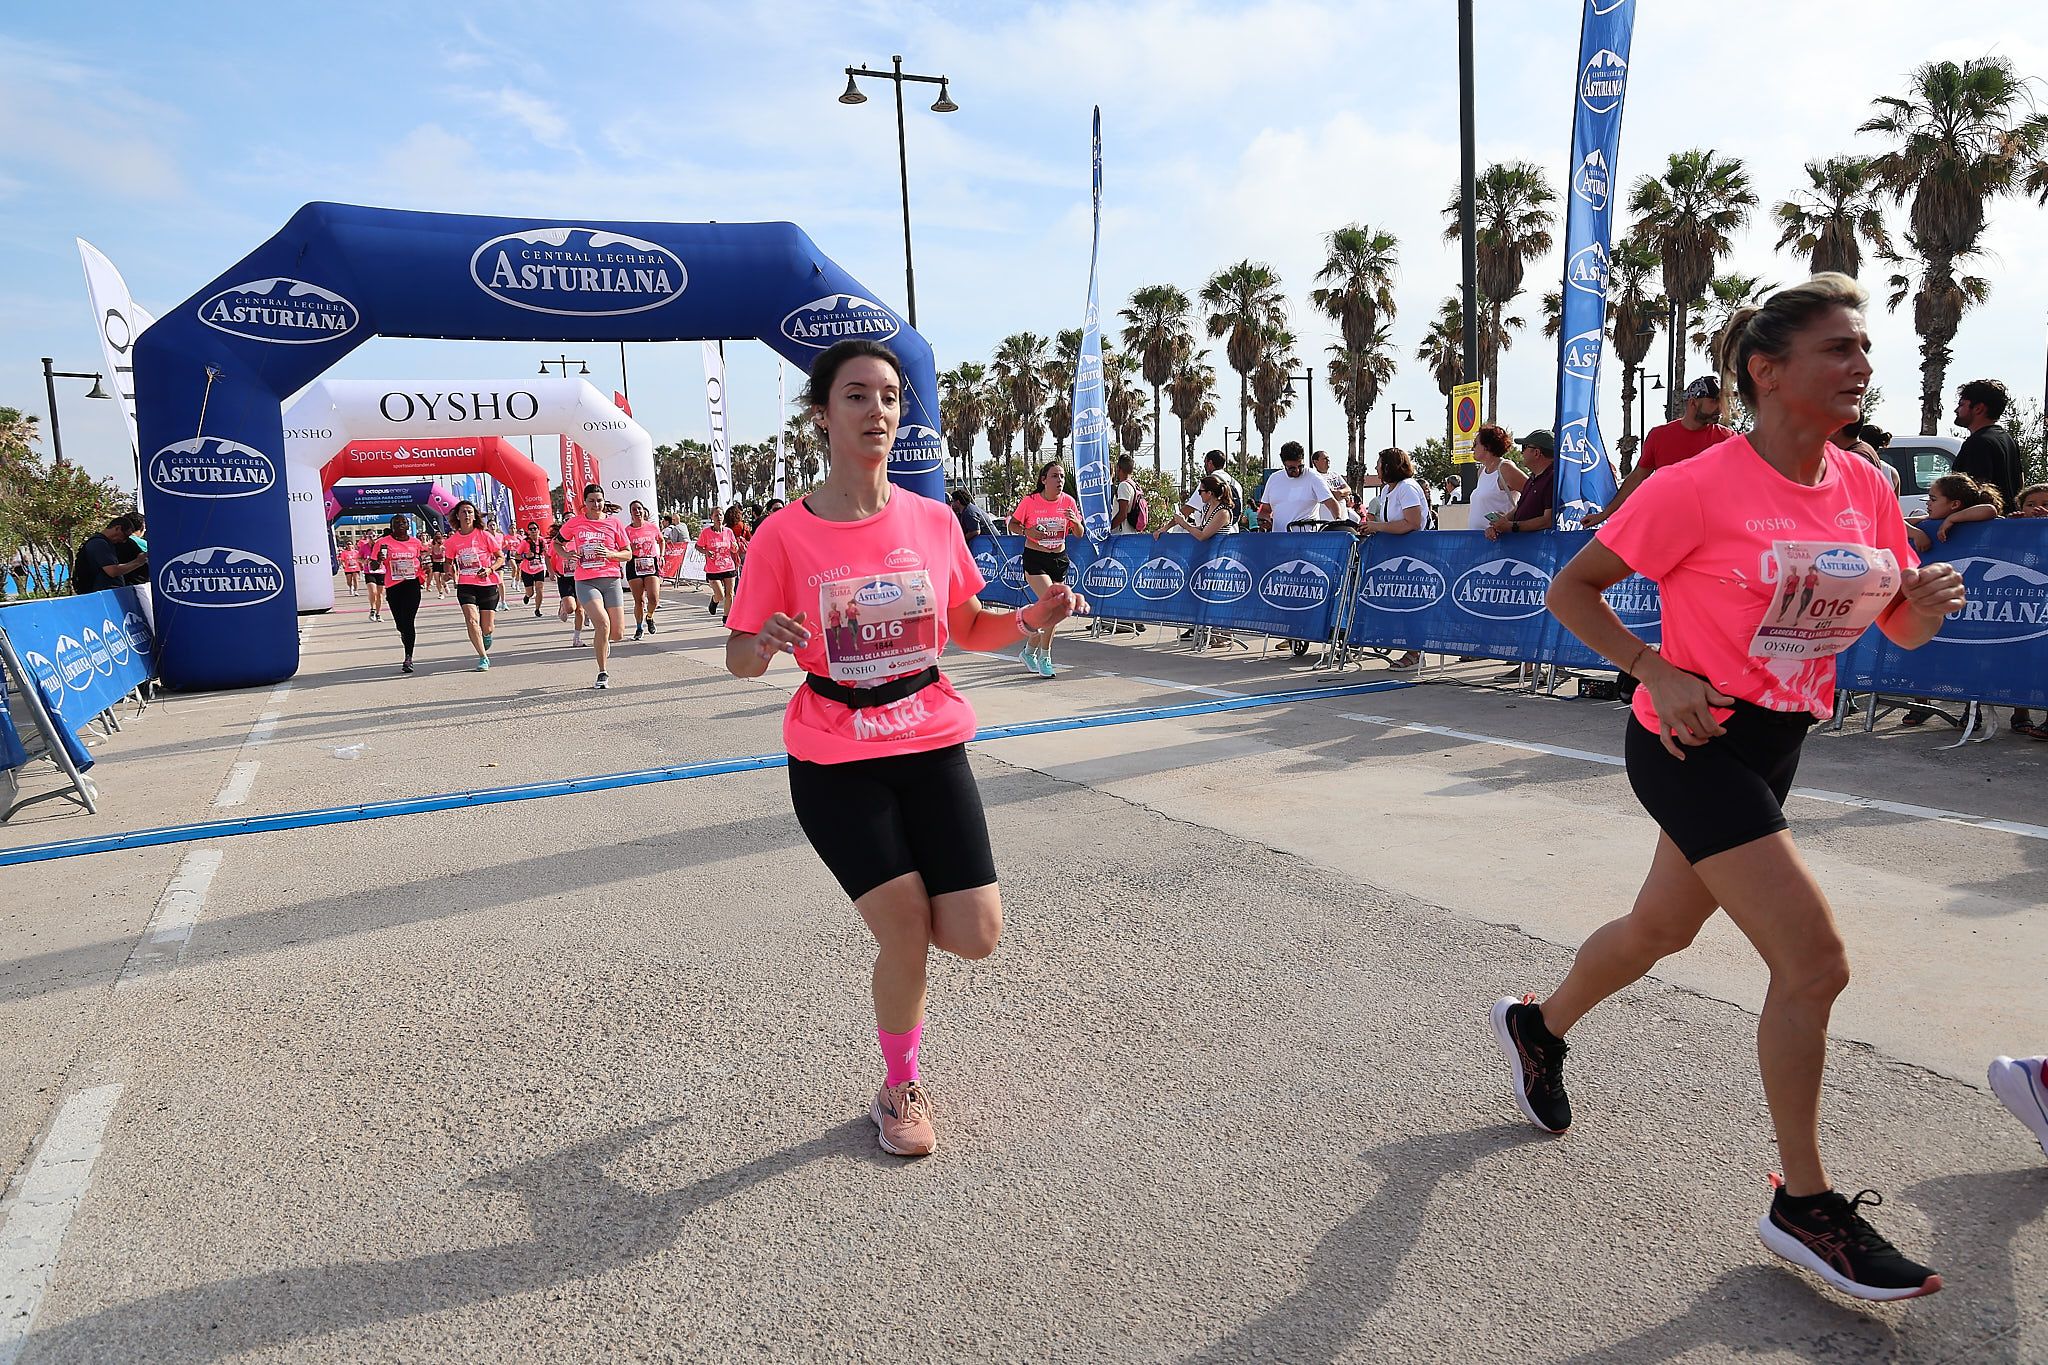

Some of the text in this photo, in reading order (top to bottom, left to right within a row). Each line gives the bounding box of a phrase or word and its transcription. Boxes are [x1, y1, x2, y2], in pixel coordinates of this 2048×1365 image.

[521, 250, 665, 264] CENTRAL LECHERA
[489, 250, 674, 294] ASTURIANA
[235, 297, 345, 312] CENTRAL LECHERA
[208, 299, 348, 330] ASTURIANA
[809, 313, 849, 321] CENTRAL
[791, 317, 896, 337] ASTURIANA
[379, 391, 539, 422] OYSHO
[583, 420, 627, 432] OYSHO
[171, 457, 265, 467] CENTRAL LECHERA
[351, 446, 477, 463] Sports Santander
[887, 447, 941, 463] STURIAN
[156, 460, 270, 484] ASTURIANA
[611, 478, 651, 490] OYSHO
[1745, 518, 1797, 532] OYSHO
[1787, 551, 1812, 560] SUMA
[181, 566, 273, 575] CENTRAL LECHERA
[1820, 559, 1866, 572] ASTURIANA
[165, 570, 278, 593] ASTURIANA
[808, 565, 851, 588] OYSHO
[1085, 571, 1123, 588] ASTURIANA
[1135, 572, 1180, 590] ASTURIANA
[1193, 573, 1246, 593] ASTURIANA
[1476, 578, 1509, 586] CENTRAL
[830, 588, 852, 599] SUMA
[858, 590, 900, 602] ASTURIANA
[1263, 577, 1324, 600] ASTURIANA
[1361, 576, 1437, 599] ASTURIANA
[1458, 579, 1546, 606] ASTURIANA
[1986, 587, 2045, 598] LECHER
[1809, 599, 1854, 618] 016
[861, 620, 904, 641] 016
[1769, 628, 1799, 637] CARRERA
[1799, 630, 1807, 639] DE
[839, 654, 865, 662] CARRERA
[881, 649, 899, 658] MUJER
[904, 643, 927, 654] VALENCIA
[874, 640, 894, 651] 1844
[1763, 640, 1806, 654] OYSHO
[841, 656, 928, 675] OYSHO Santander
[853, 700, 934, 741] MUJER
